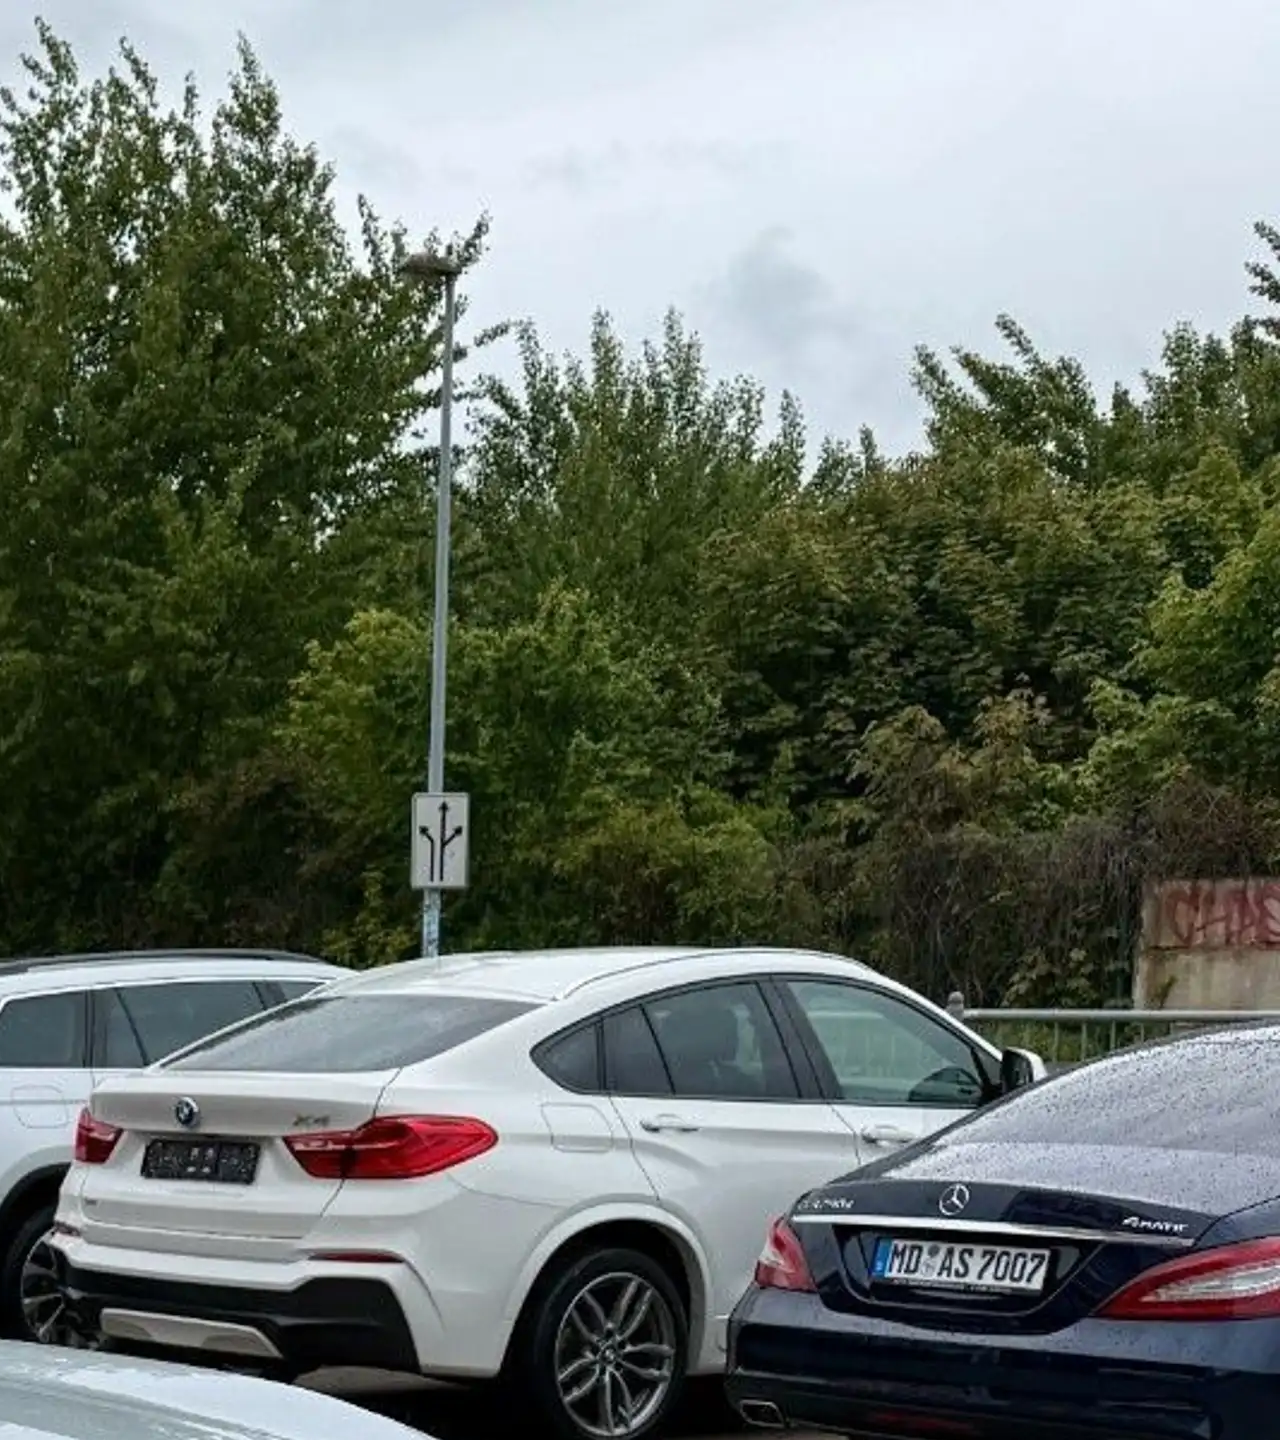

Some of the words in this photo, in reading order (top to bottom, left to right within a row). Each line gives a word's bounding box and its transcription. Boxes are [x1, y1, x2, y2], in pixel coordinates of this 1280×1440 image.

[890, 1243, 922, 1274] MD
[937, 1246, 974, 1279] AS
[977, 1250, 1047, 1284] 7007
